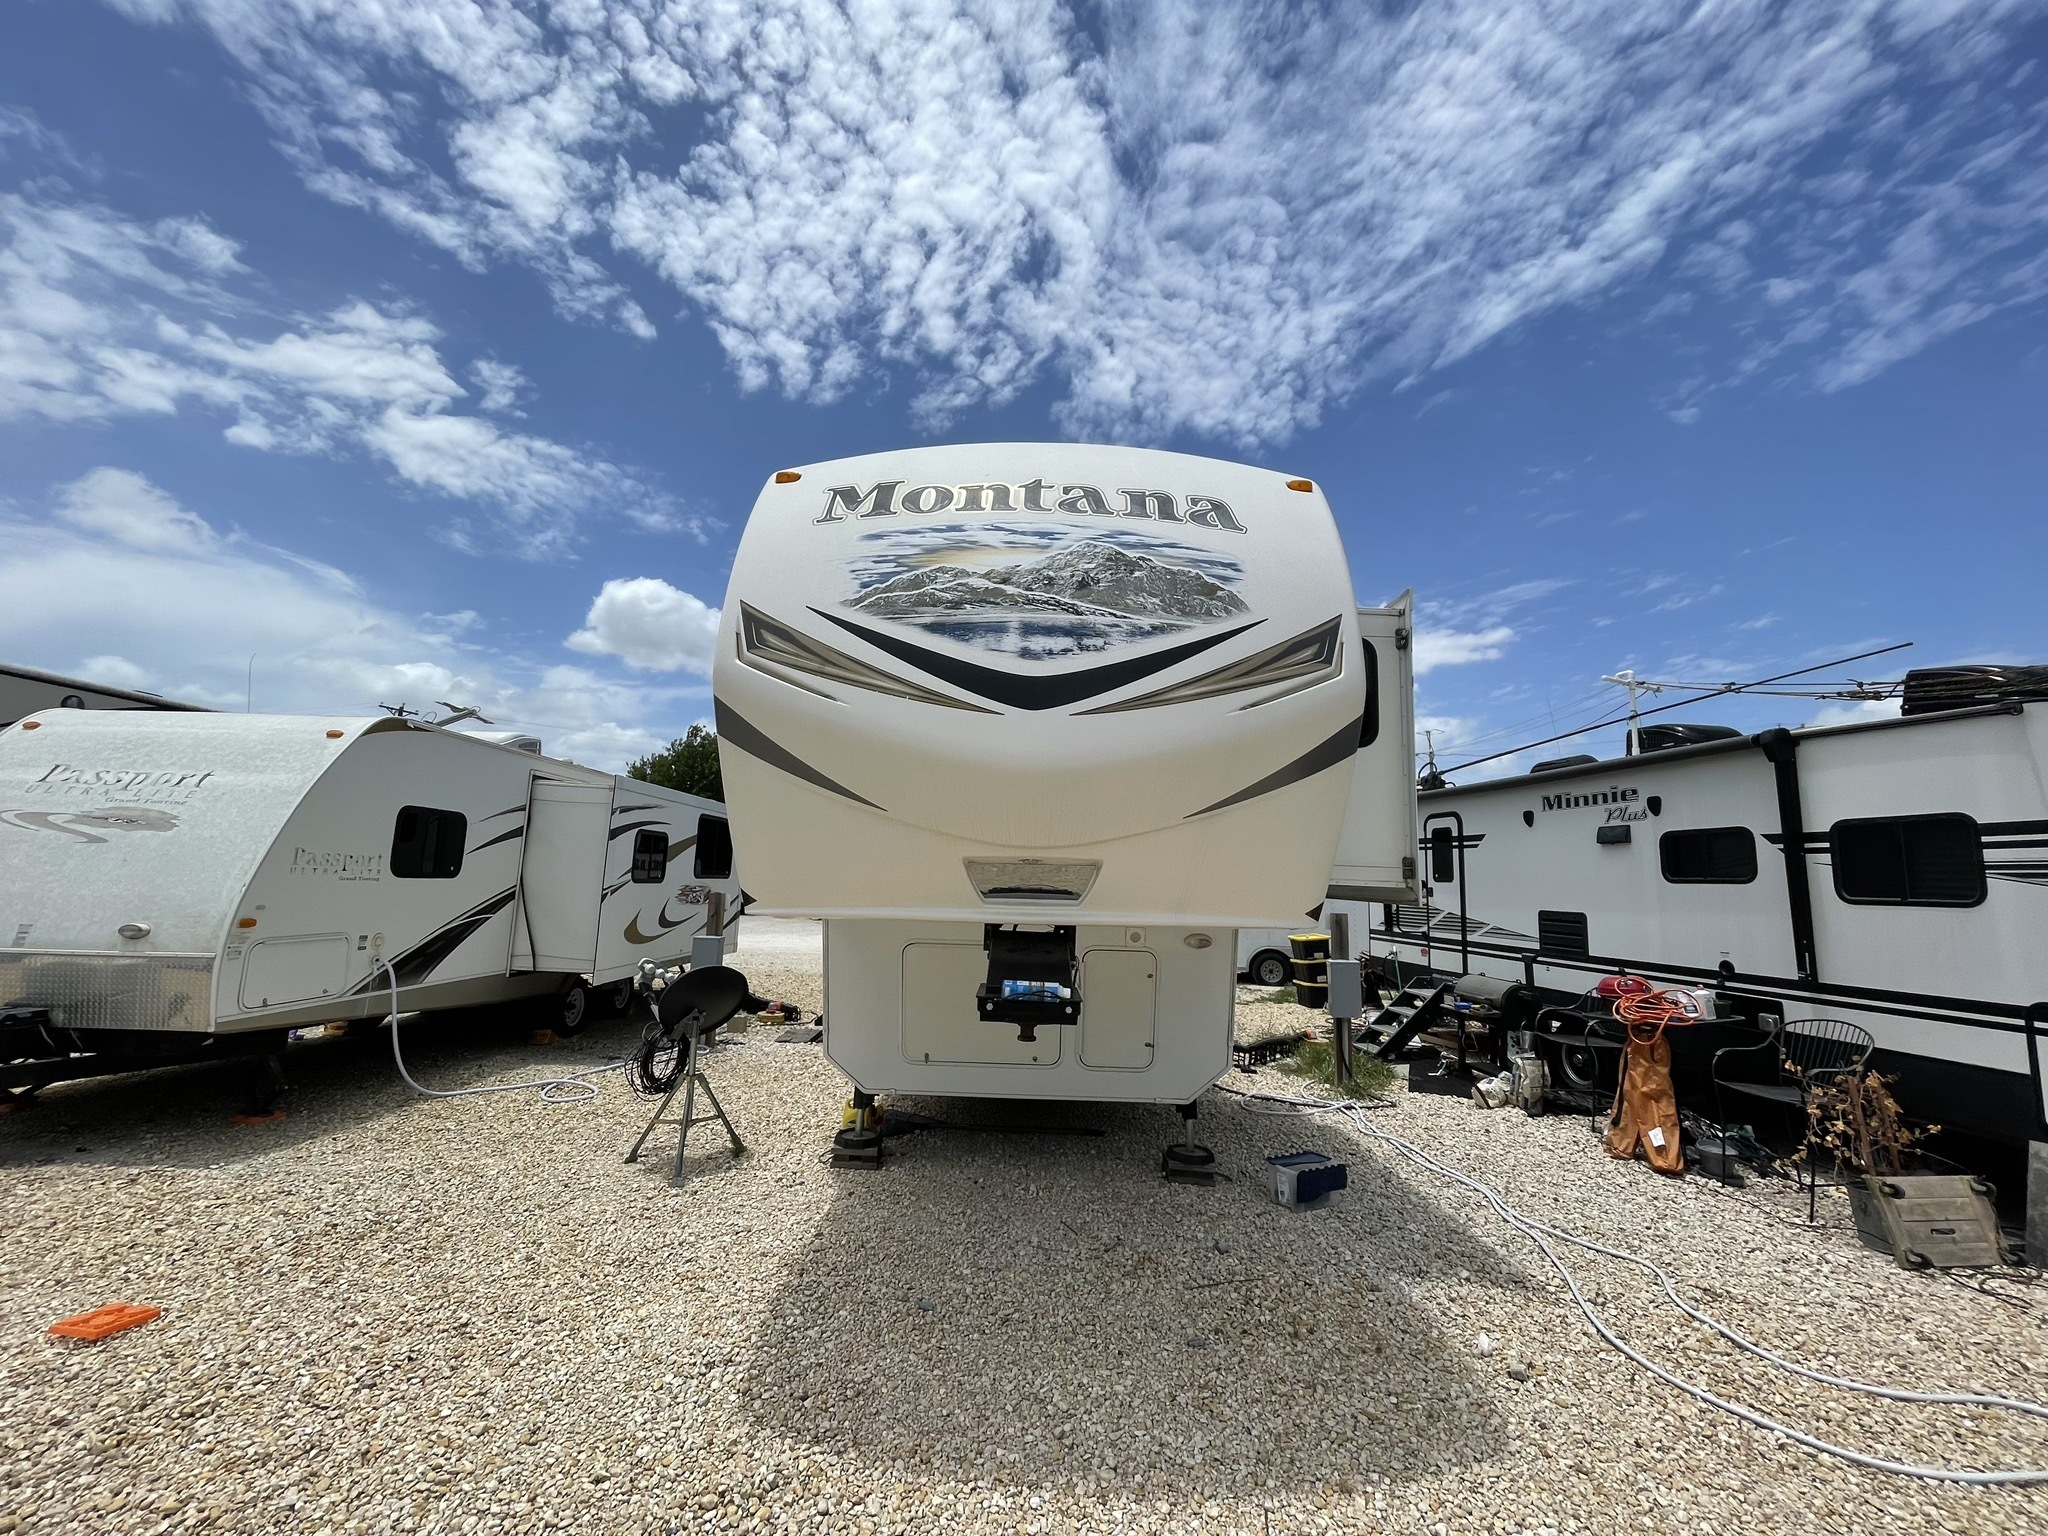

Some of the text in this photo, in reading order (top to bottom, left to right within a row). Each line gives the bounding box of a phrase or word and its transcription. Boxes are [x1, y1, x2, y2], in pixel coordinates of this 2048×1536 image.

[813, 477, 1249, 535] Montana
[36, 764, 215, 791] Passport
[25, 784, 199, 799] ULTRA LITE
[1541, 785, 1640, 812] Minnie
[1604, 804, 1648, 824] Plus
[291, 846, 384, 872] Passport
